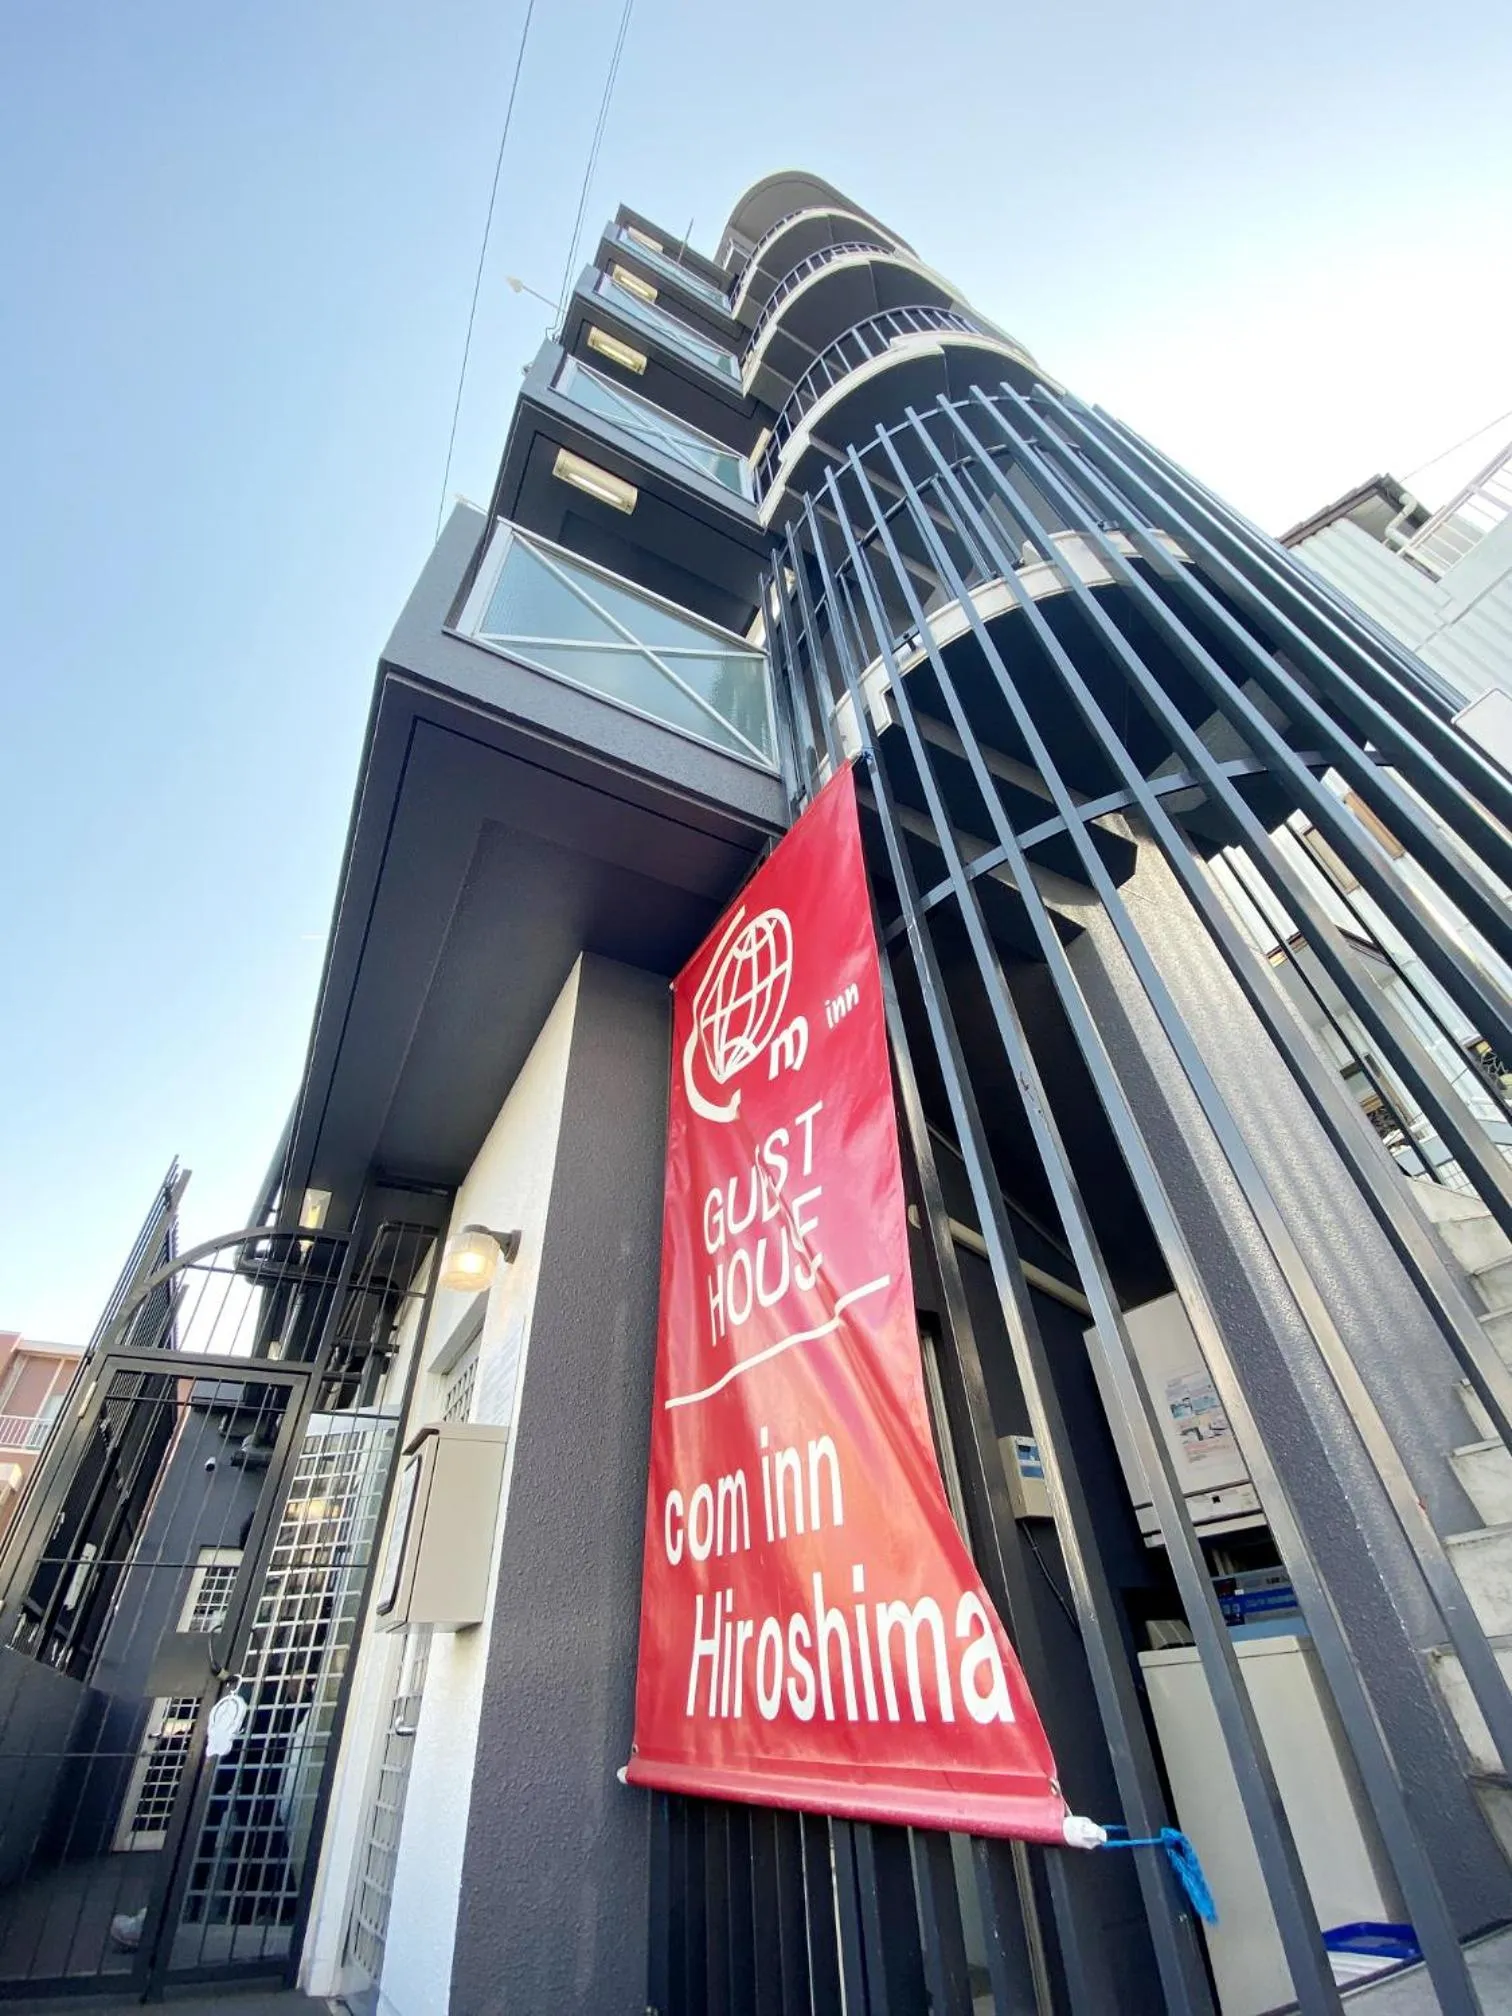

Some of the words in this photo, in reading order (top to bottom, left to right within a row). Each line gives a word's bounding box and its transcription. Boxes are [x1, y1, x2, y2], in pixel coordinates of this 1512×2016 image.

[824, 982, 859, 1028] inn
[665, 1467, 751, 1566] com
[761, 1427, 843, 1543] inn
[687, 1564, 1016, 1725] Hiroshima
